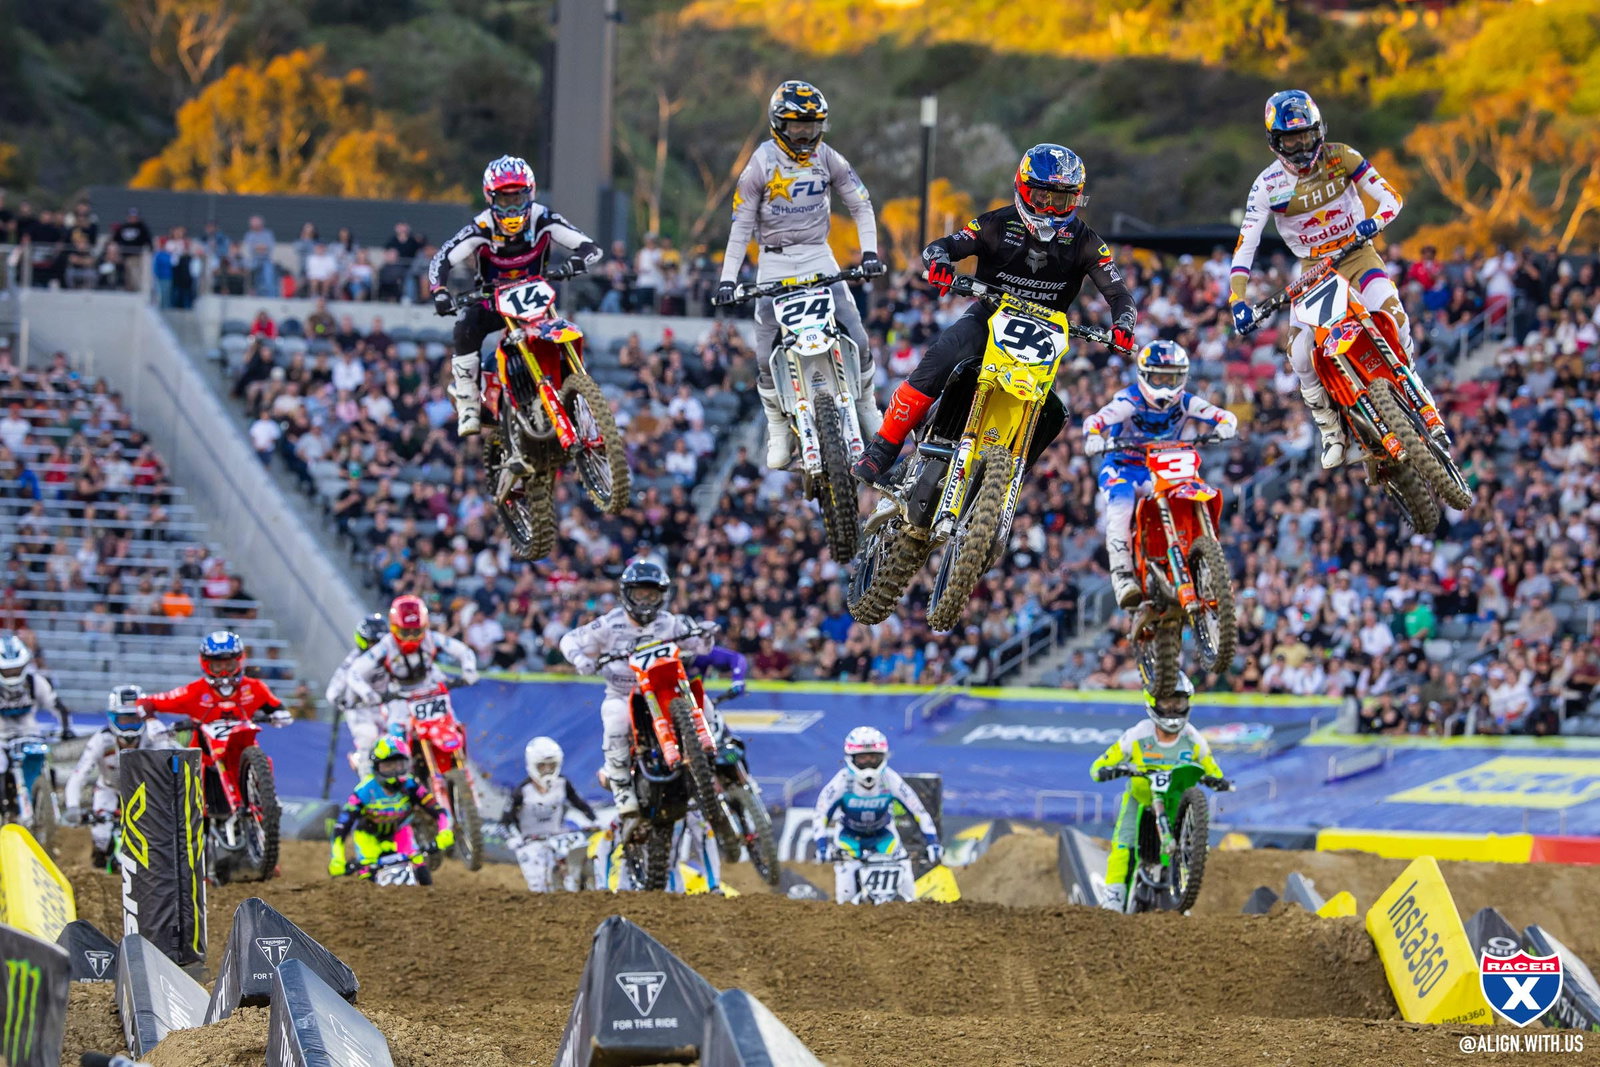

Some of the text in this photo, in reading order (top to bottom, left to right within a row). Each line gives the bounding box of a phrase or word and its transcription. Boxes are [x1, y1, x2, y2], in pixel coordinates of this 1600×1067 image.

[1299, 213, 1355, 246] Red Bull
[996, 271, 1067, 291] PROGRESSIVE
[1001, 283, 1058, 301] SUZUKI
[507, 284, 550, 315] 14
[781, 298, 832, 326] 24
[1305, 279, 1338, 327] 7
[1002, 318, 1054, 360] 94
[1157, 452, 1196, 479] 3
[944, 458, 965, 509] DUNLOP
[1002, 480, 1018, 529] DUNLOP
[415, 699, 447, 720] 874
[865, 870, 900, 890] 411
[1387, 880, 1449, 998] Insta360
[613, 1017, 679, 1030] FOR THE RIDE
